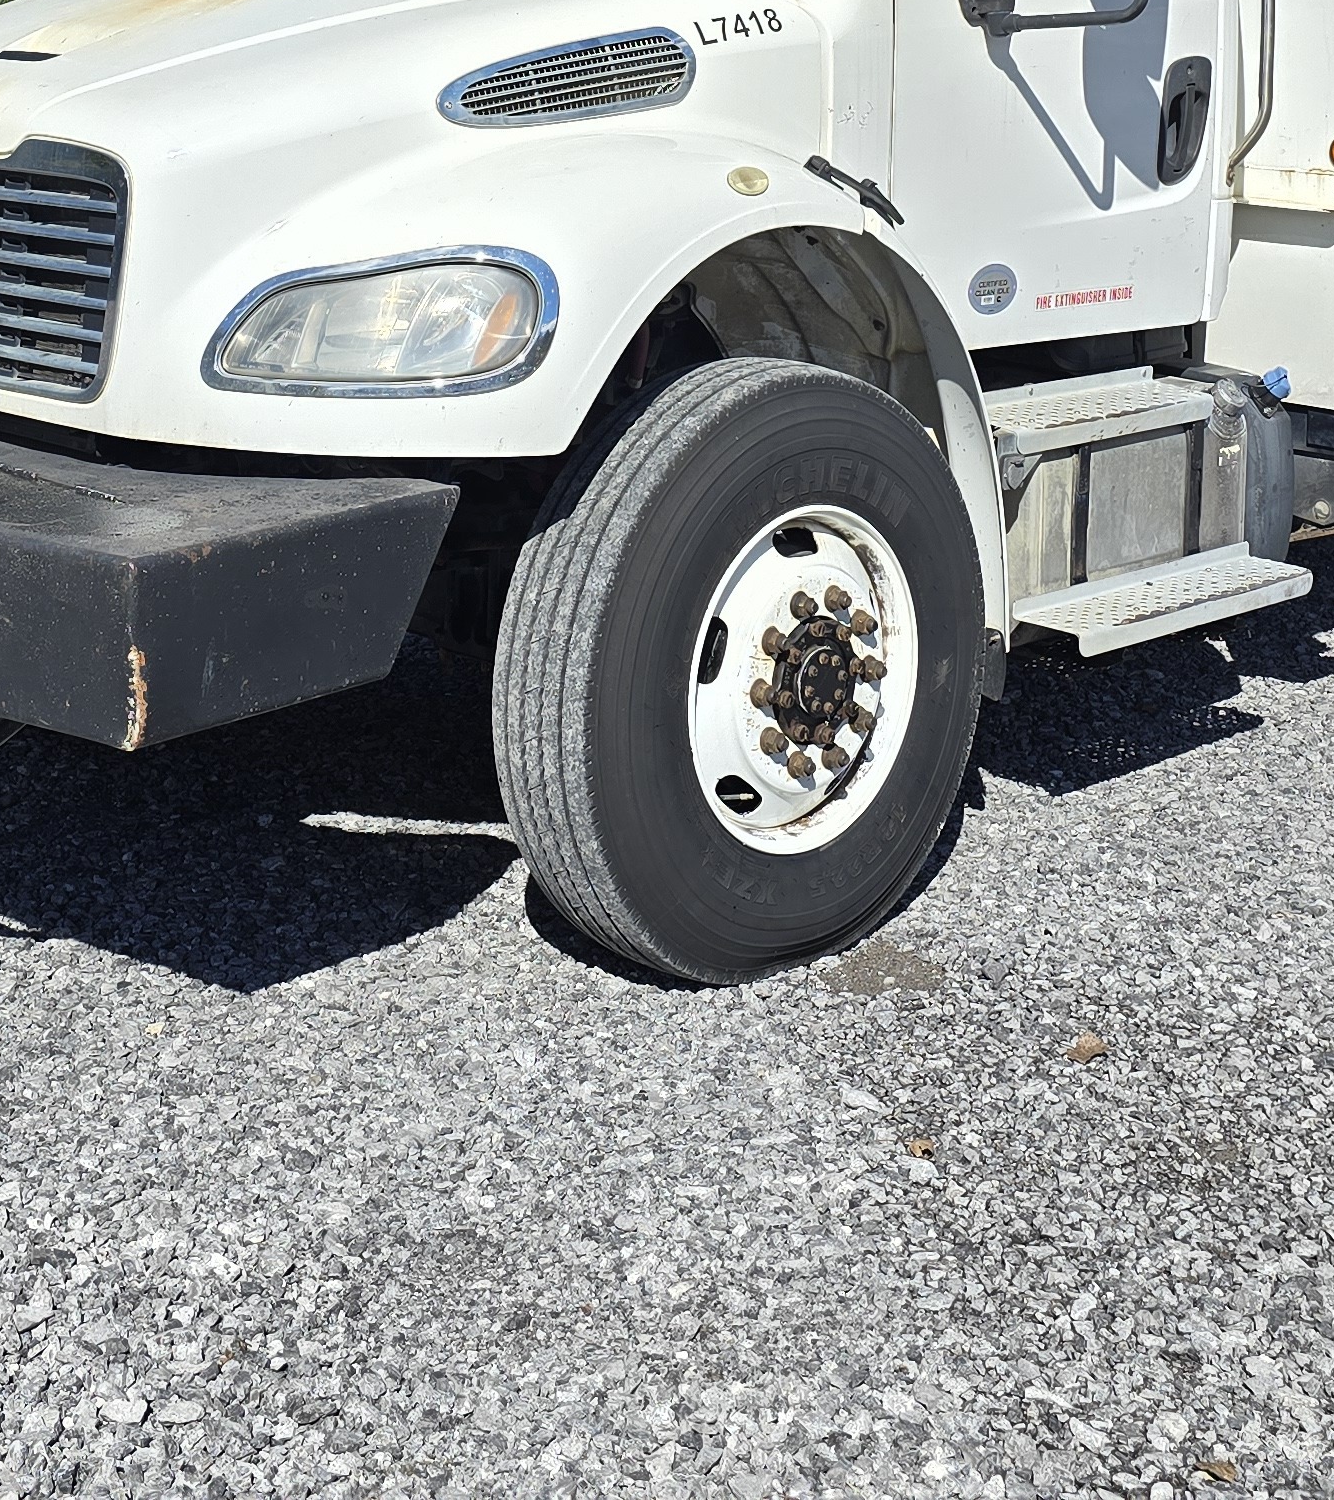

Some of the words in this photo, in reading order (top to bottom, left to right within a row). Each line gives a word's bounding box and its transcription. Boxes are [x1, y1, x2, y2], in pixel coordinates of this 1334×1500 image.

[693, 8, 782, 46] L7418
[975, 289, 995, 297] CLEAN
[1035, 295, 1053, 310] FIRE
[1055, 289, 1107, 308] EXTINGUISHER
[1109, 286, 1133, 301] INSIDE
